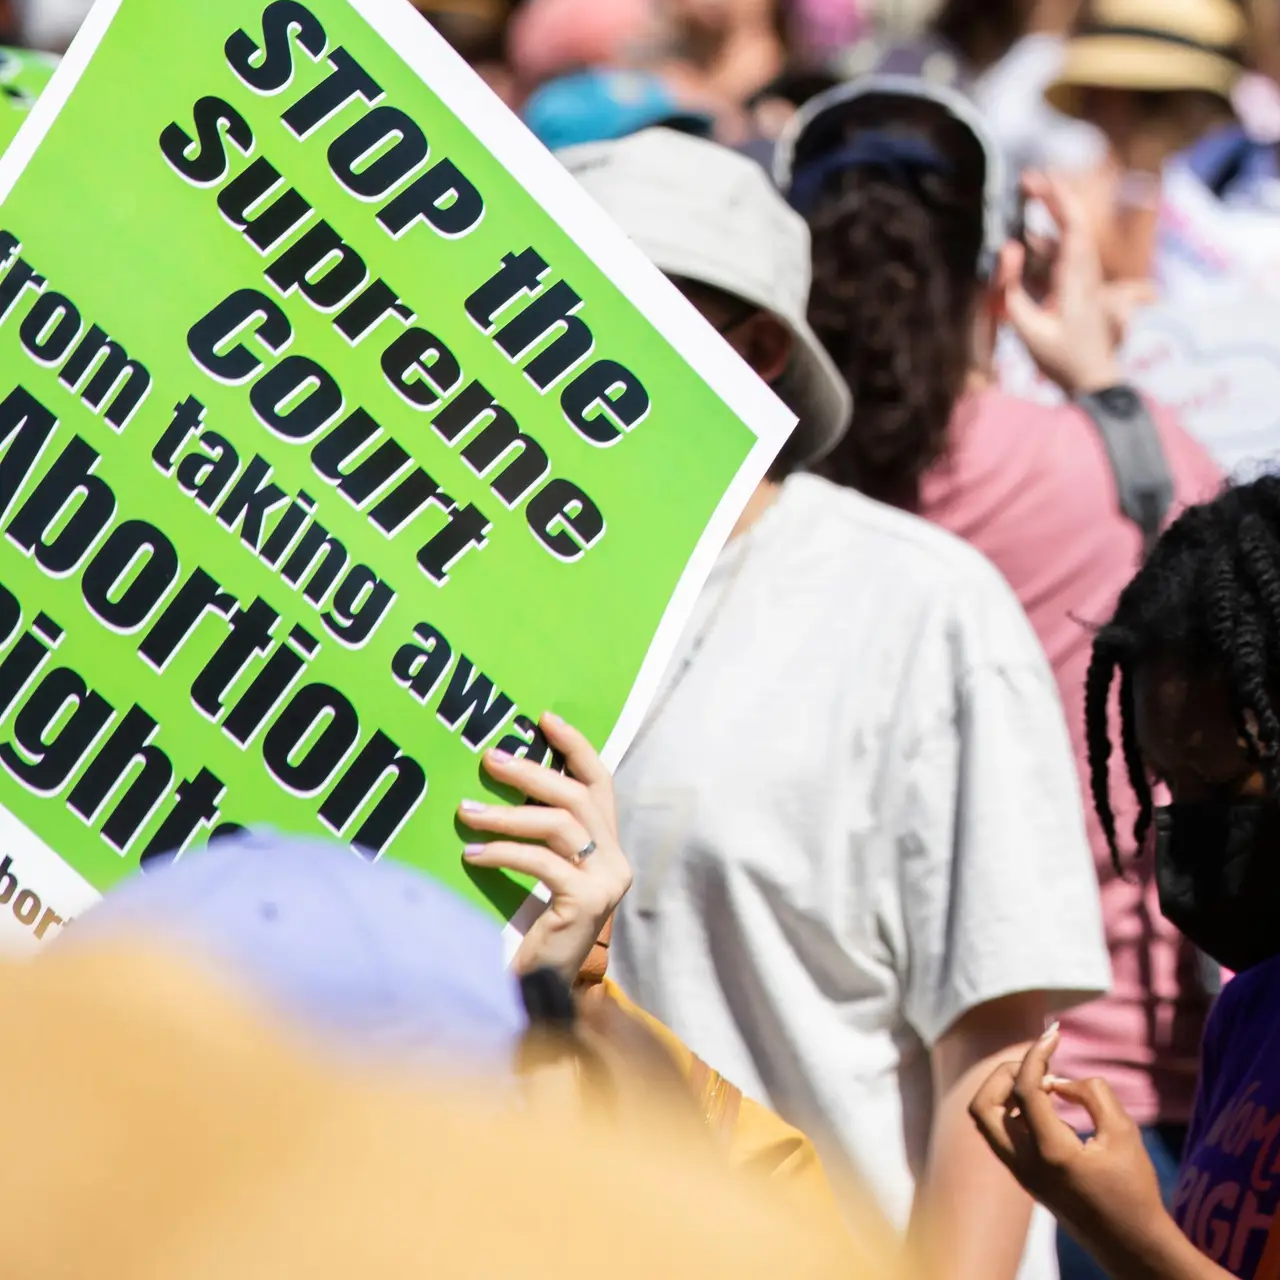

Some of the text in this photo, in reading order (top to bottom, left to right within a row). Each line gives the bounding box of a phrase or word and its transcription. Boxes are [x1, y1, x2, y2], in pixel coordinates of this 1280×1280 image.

[159, 95, 606, 563] Supreme
[187, 288, 493, 588] Court
[464, 246, 651, 449] the
[0, 384, 428, 863] Abortion
[0, 580, 256, 876] ight
[151, 394, 398, 650] taking
[390, 621, 573, 806] awa
